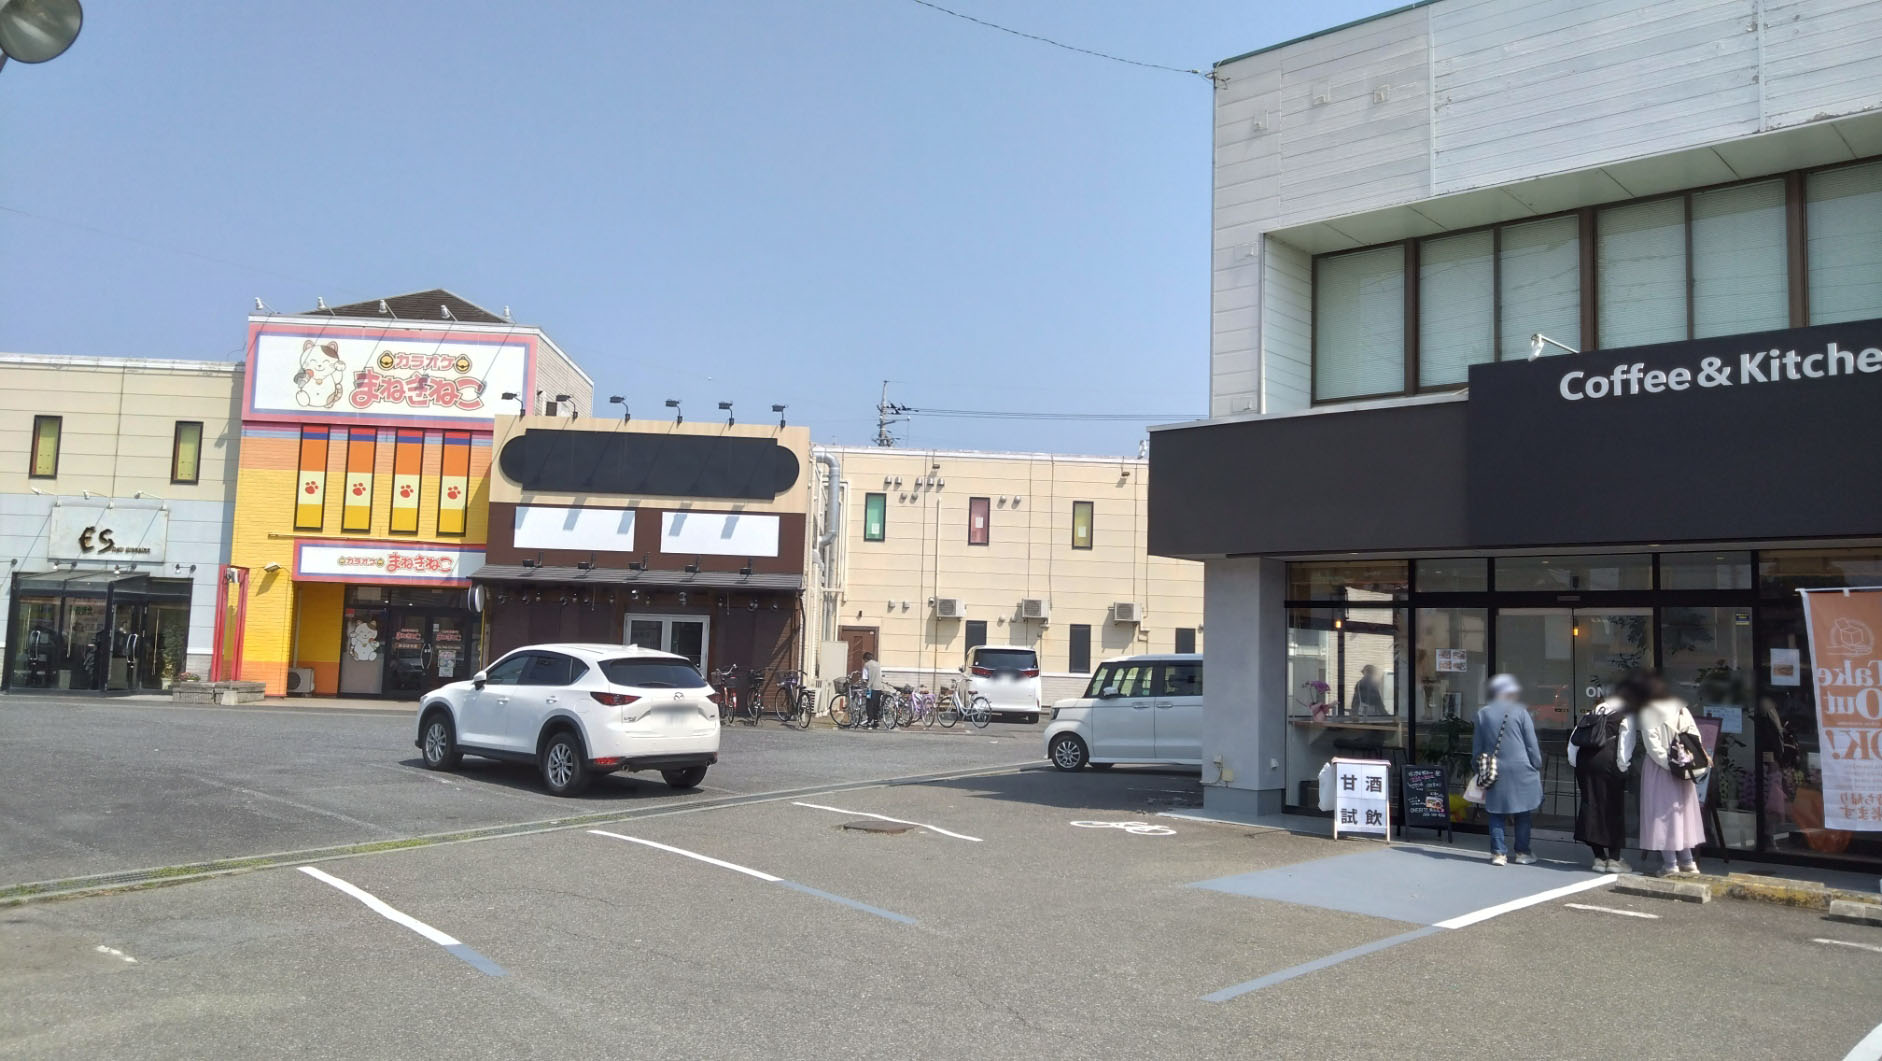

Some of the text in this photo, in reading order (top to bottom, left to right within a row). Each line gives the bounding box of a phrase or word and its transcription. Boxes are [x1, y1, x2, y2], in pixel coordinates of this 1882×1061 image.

[394, 353, 455, 371] カラオケ
[1559, 342, 1882, 401] Coffee & Kitche
[350, 367, 485, 411] まねきねこ
[386, 552, 454, 573] まねきねこ
[1340, 774, 1383, 793] 甘酒
[1340, 808, 1384, 827] 試飲
